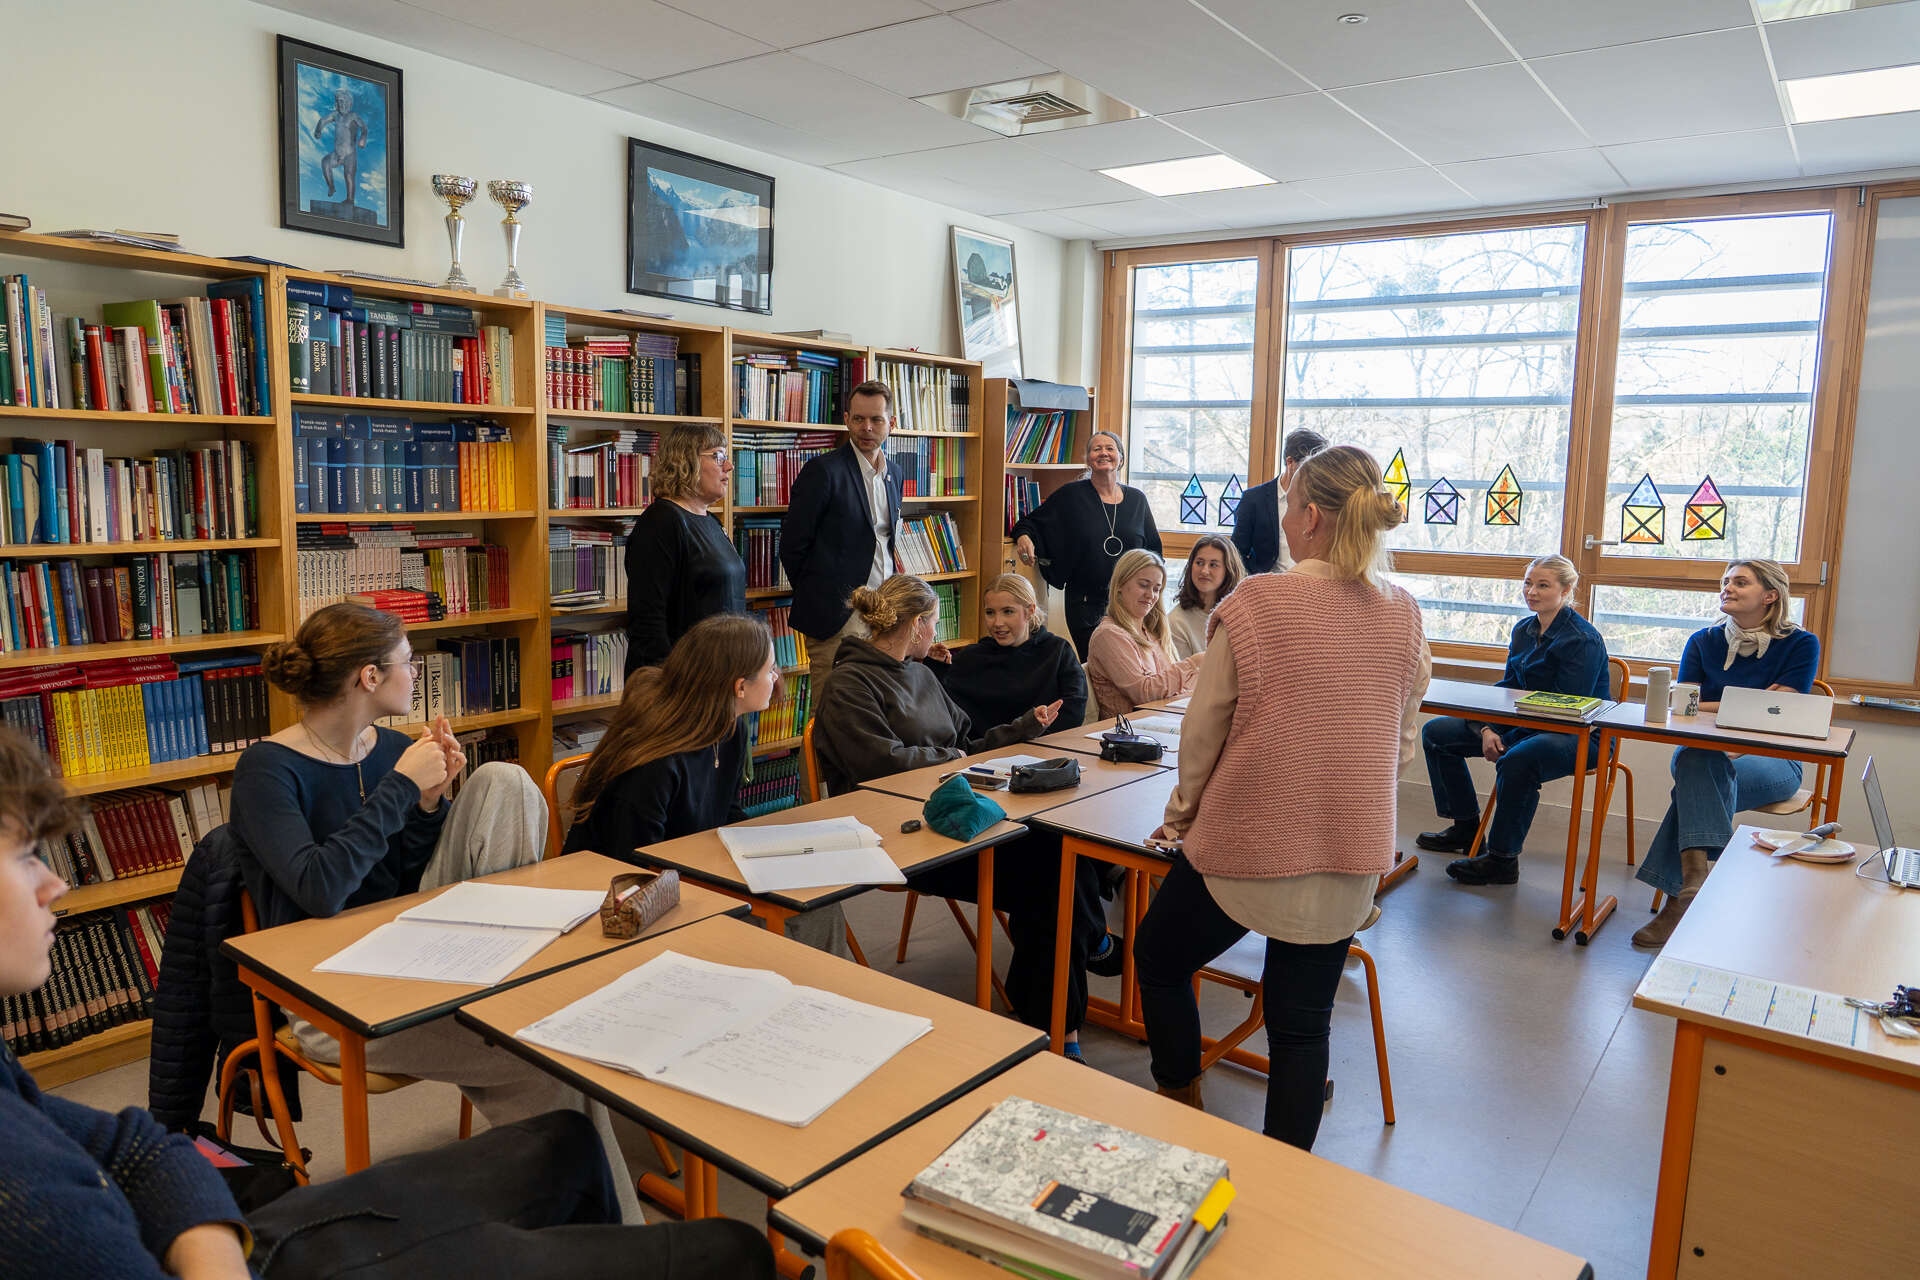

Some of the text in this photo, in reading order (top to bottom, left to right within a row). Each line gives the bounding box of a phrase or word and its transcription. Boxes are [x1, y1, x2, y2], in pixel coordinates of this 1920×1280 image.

[370, 312, 398, 321] TANUMS
[137, 565, 147, 607] KORANEN
[132, 664, 162, 672] ARVINGEN
[134, 674, 166, 682] ARVINGEN
[39, 679, 73, 690] ARVINGEN
[431, 670, 442, 708] Beatles
[68, 934, 84, 967] Aschehougs
[97, 924, 113, 956] Aschehougs
[109, 922, 123, 954] Aschehougs
[1060, 1191, 1098, 1222] Pilot
